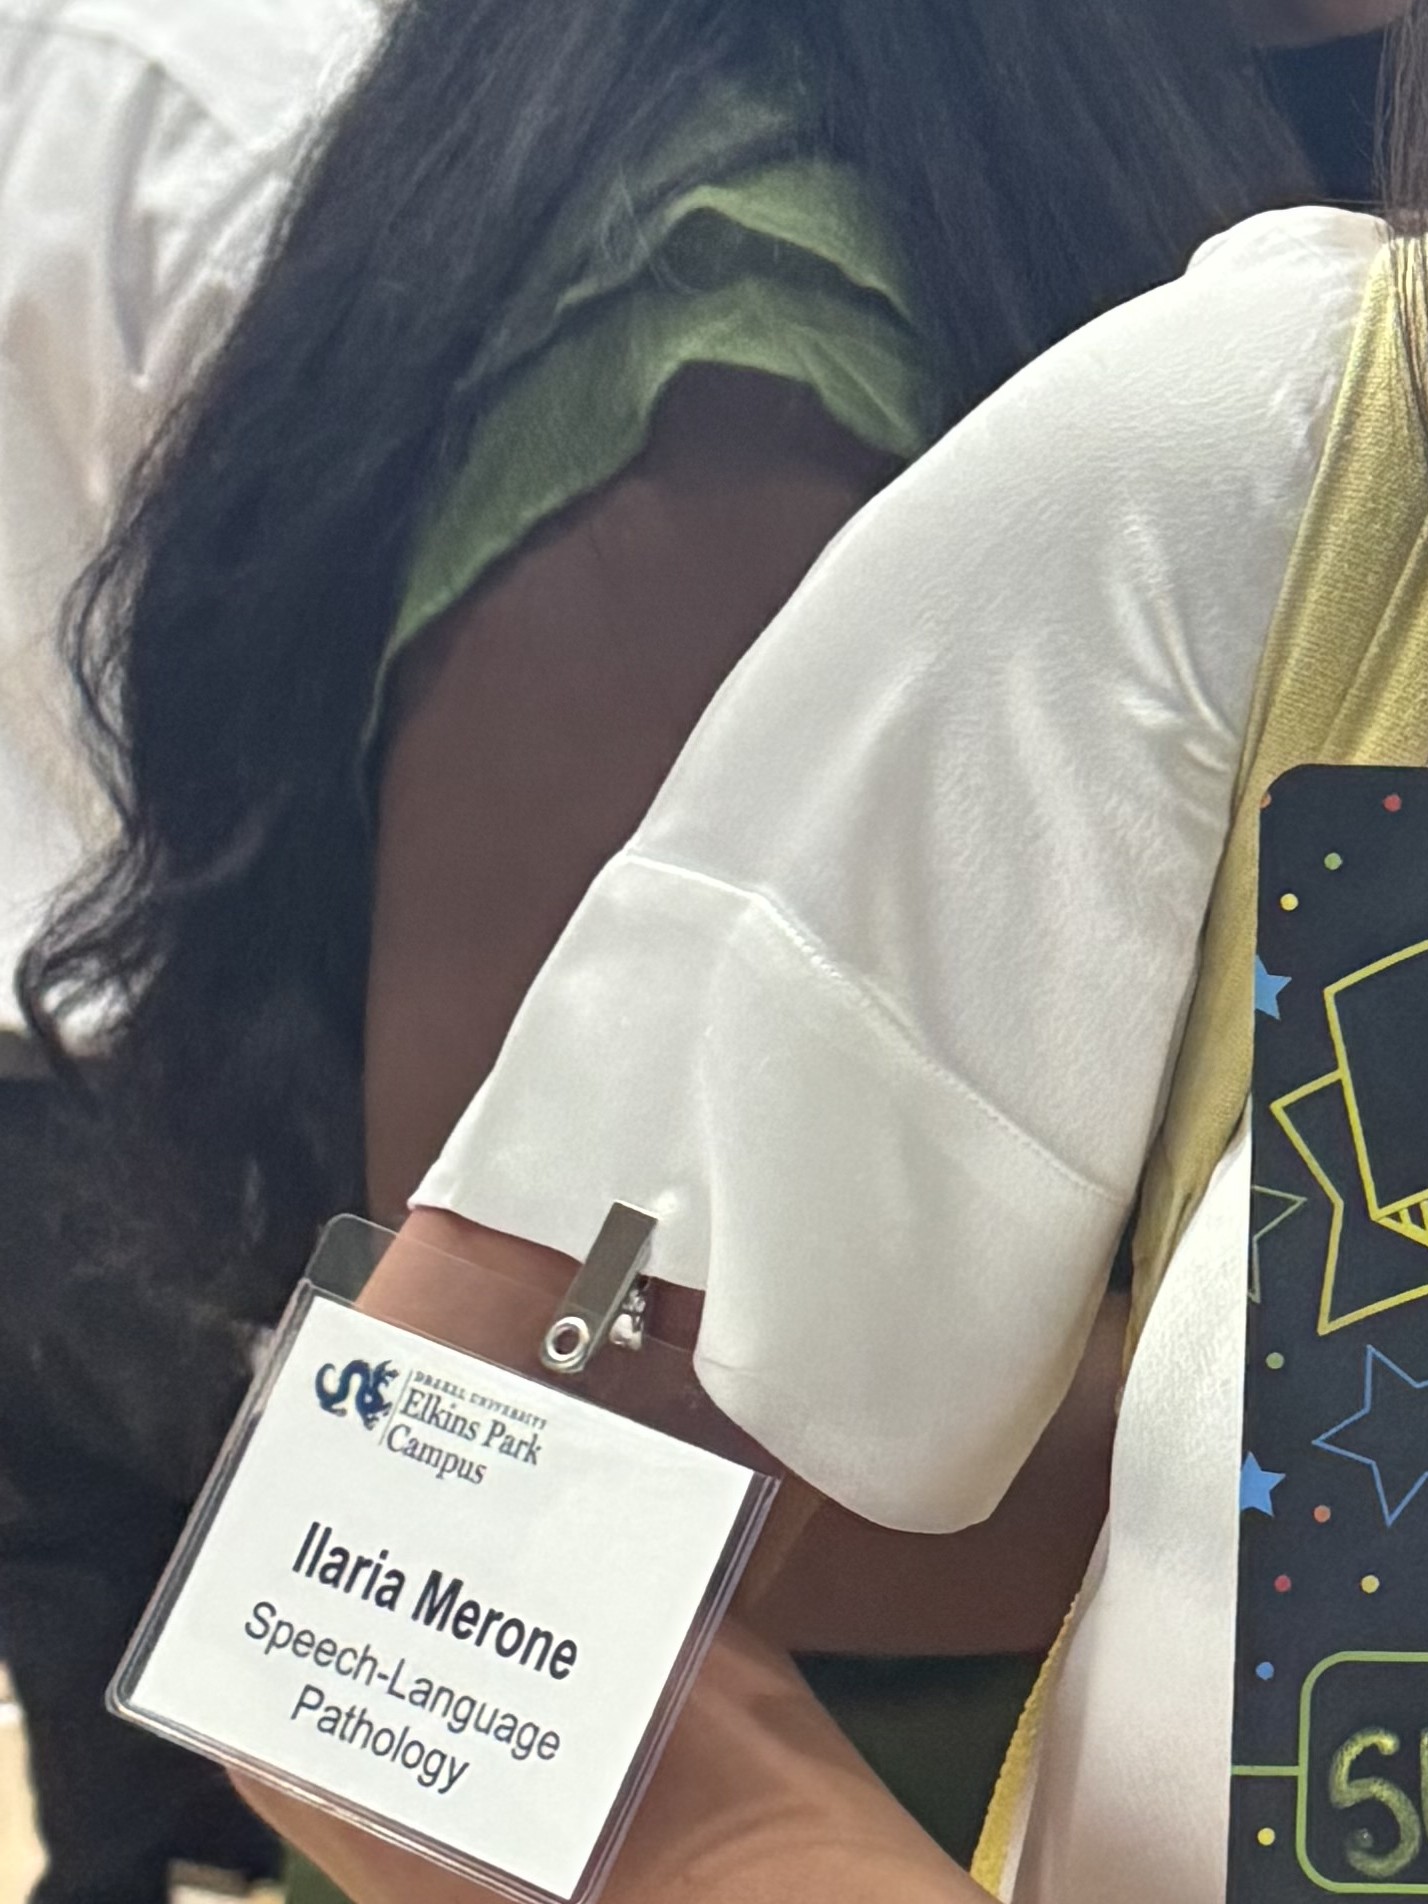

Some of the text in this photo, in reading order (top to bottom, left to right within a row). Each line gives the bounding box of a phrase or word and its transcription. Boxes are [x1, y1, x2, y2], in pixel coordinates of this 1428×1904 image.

[386, 1423, 487, 1484] Campus
[399, 1387, 543, 1466] Elkins Park
[292, 1520, 578, 1680] Ilaria Merone
[244, 1600, 561, 1761] Speech-Language
[290, 1683, 470, 1795] Pathology
